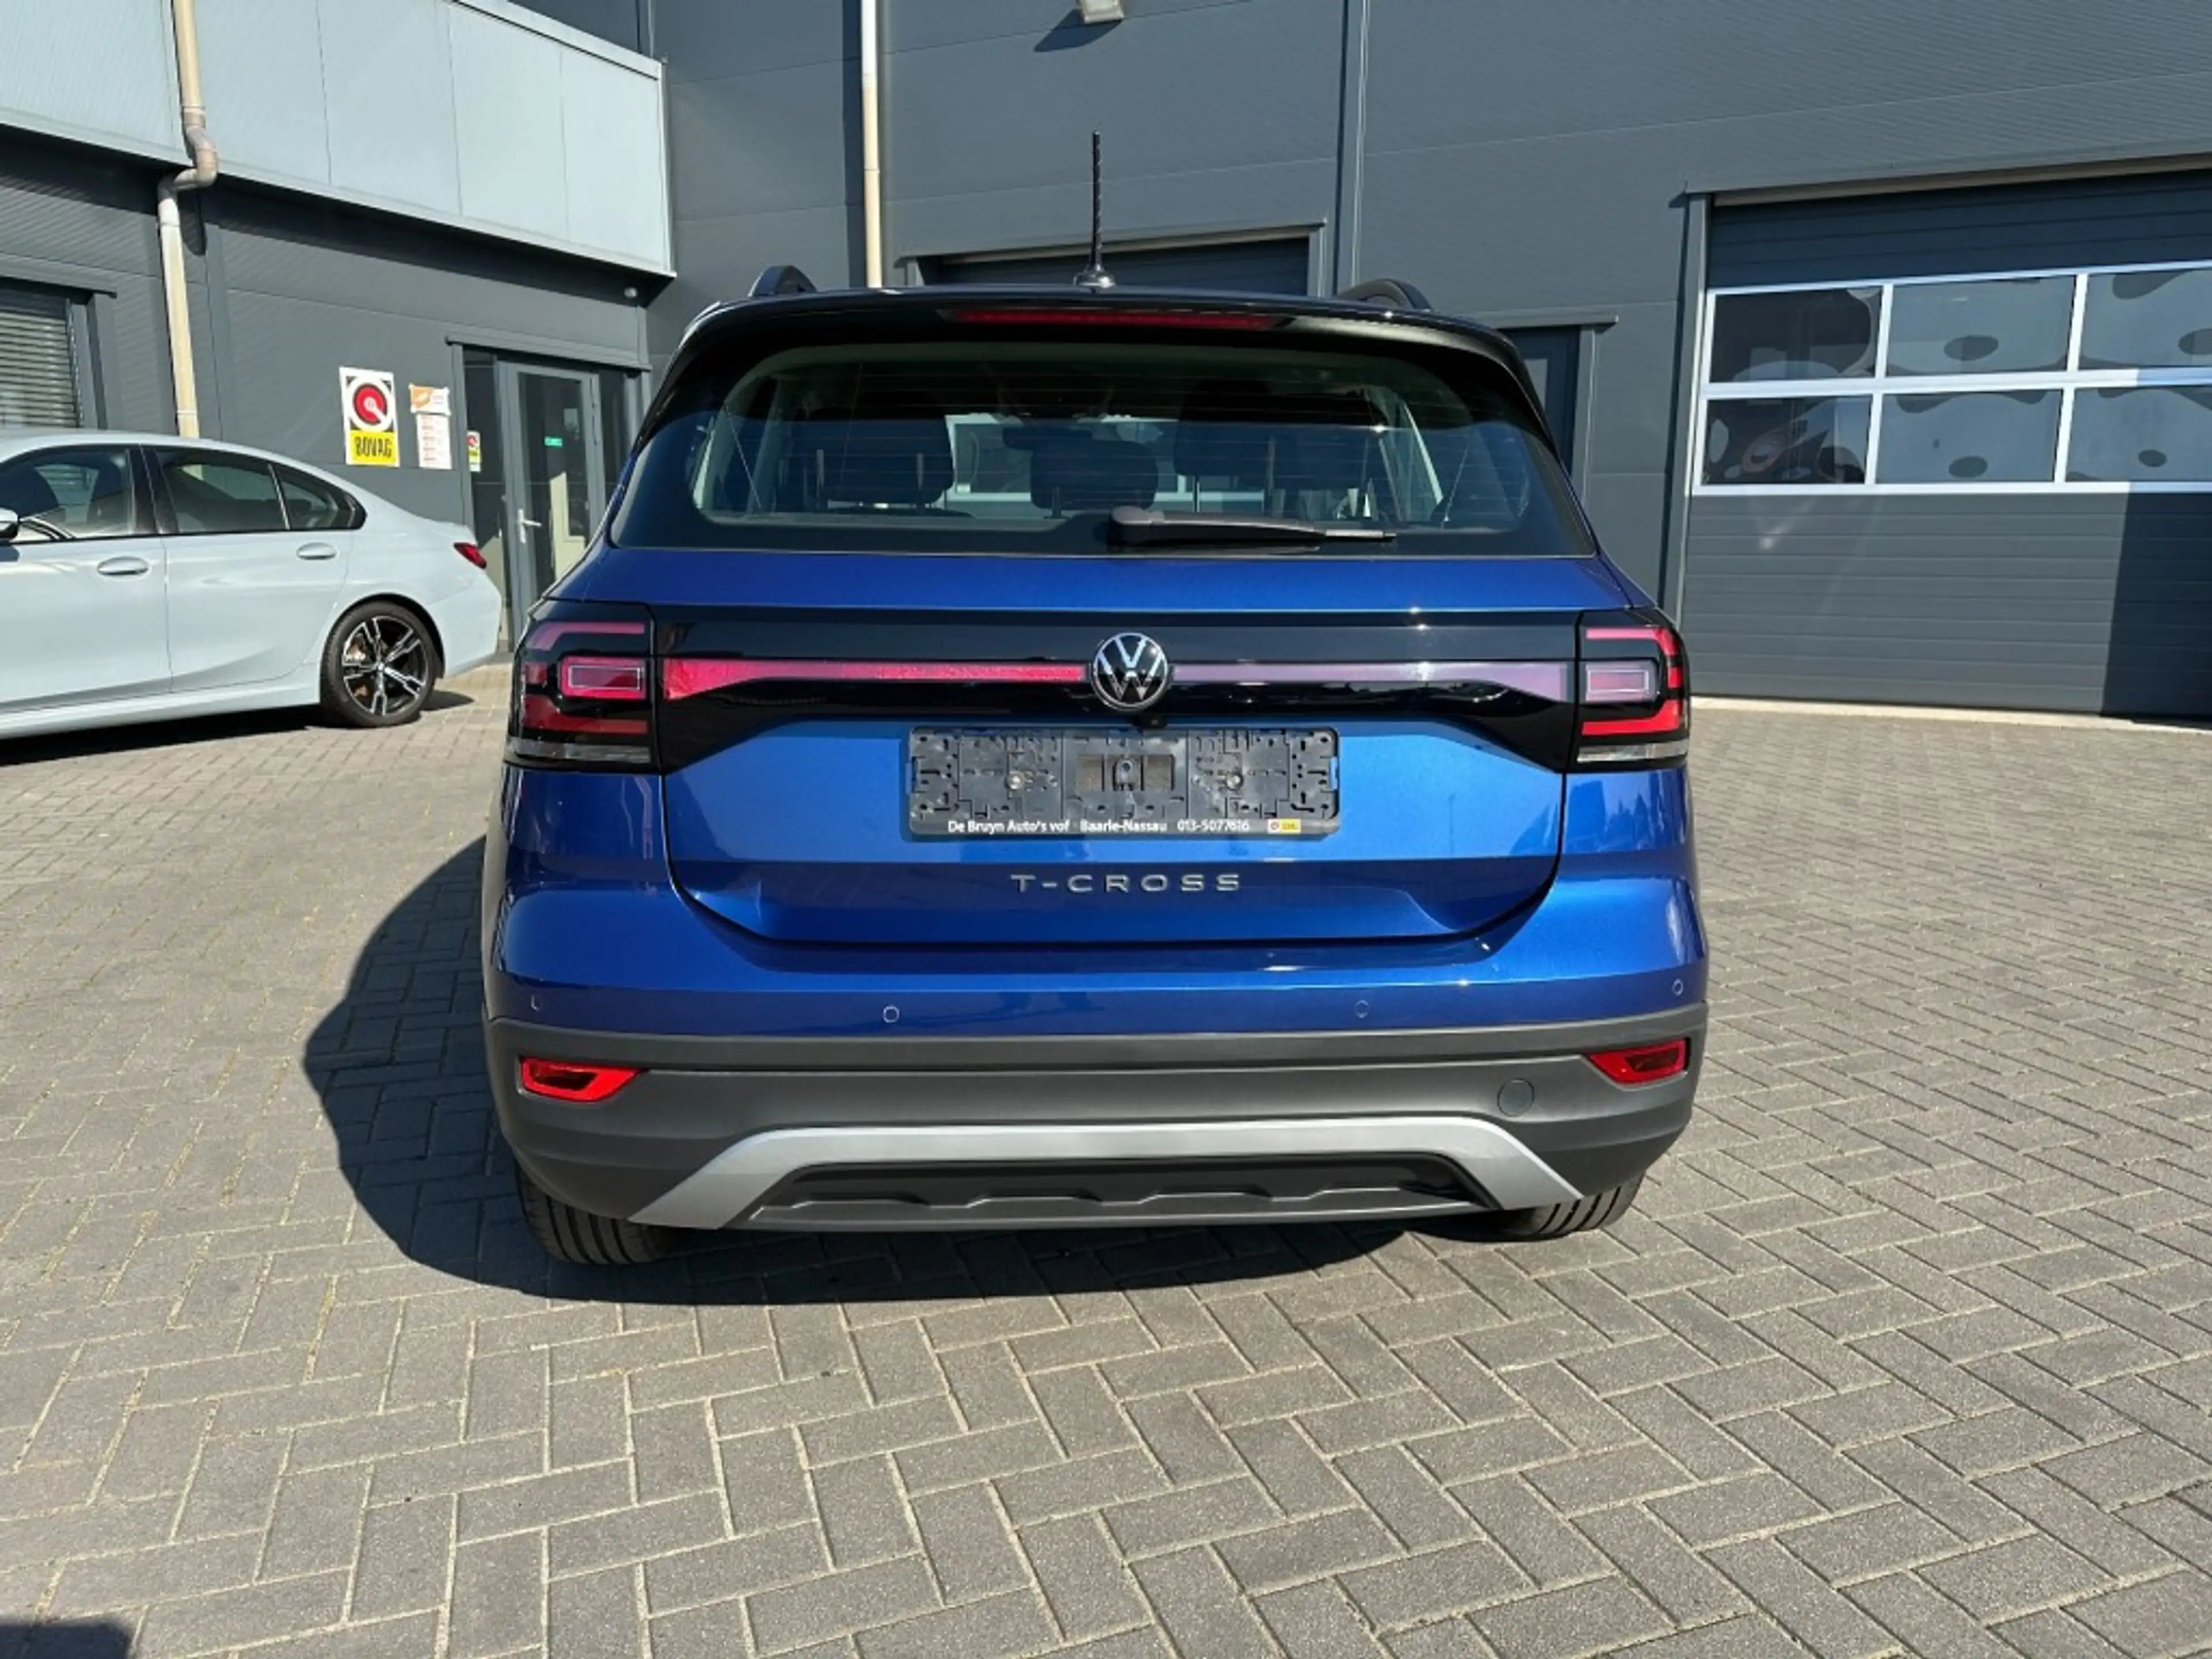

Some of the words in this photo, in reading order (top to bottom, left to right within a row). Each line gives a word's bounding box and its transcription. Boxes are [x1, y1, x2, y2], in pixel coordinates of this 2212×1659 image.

[354, 436, 392, 457] BOVAG
[948, 821, 964, 832] De
[968, 820, 1004, 835] Bruyn
[1007, 820, 1047, 832] Auto's
[1049, 819, 1070, 832] vof
[1010, 874, 1240, 893] T-CROSS
